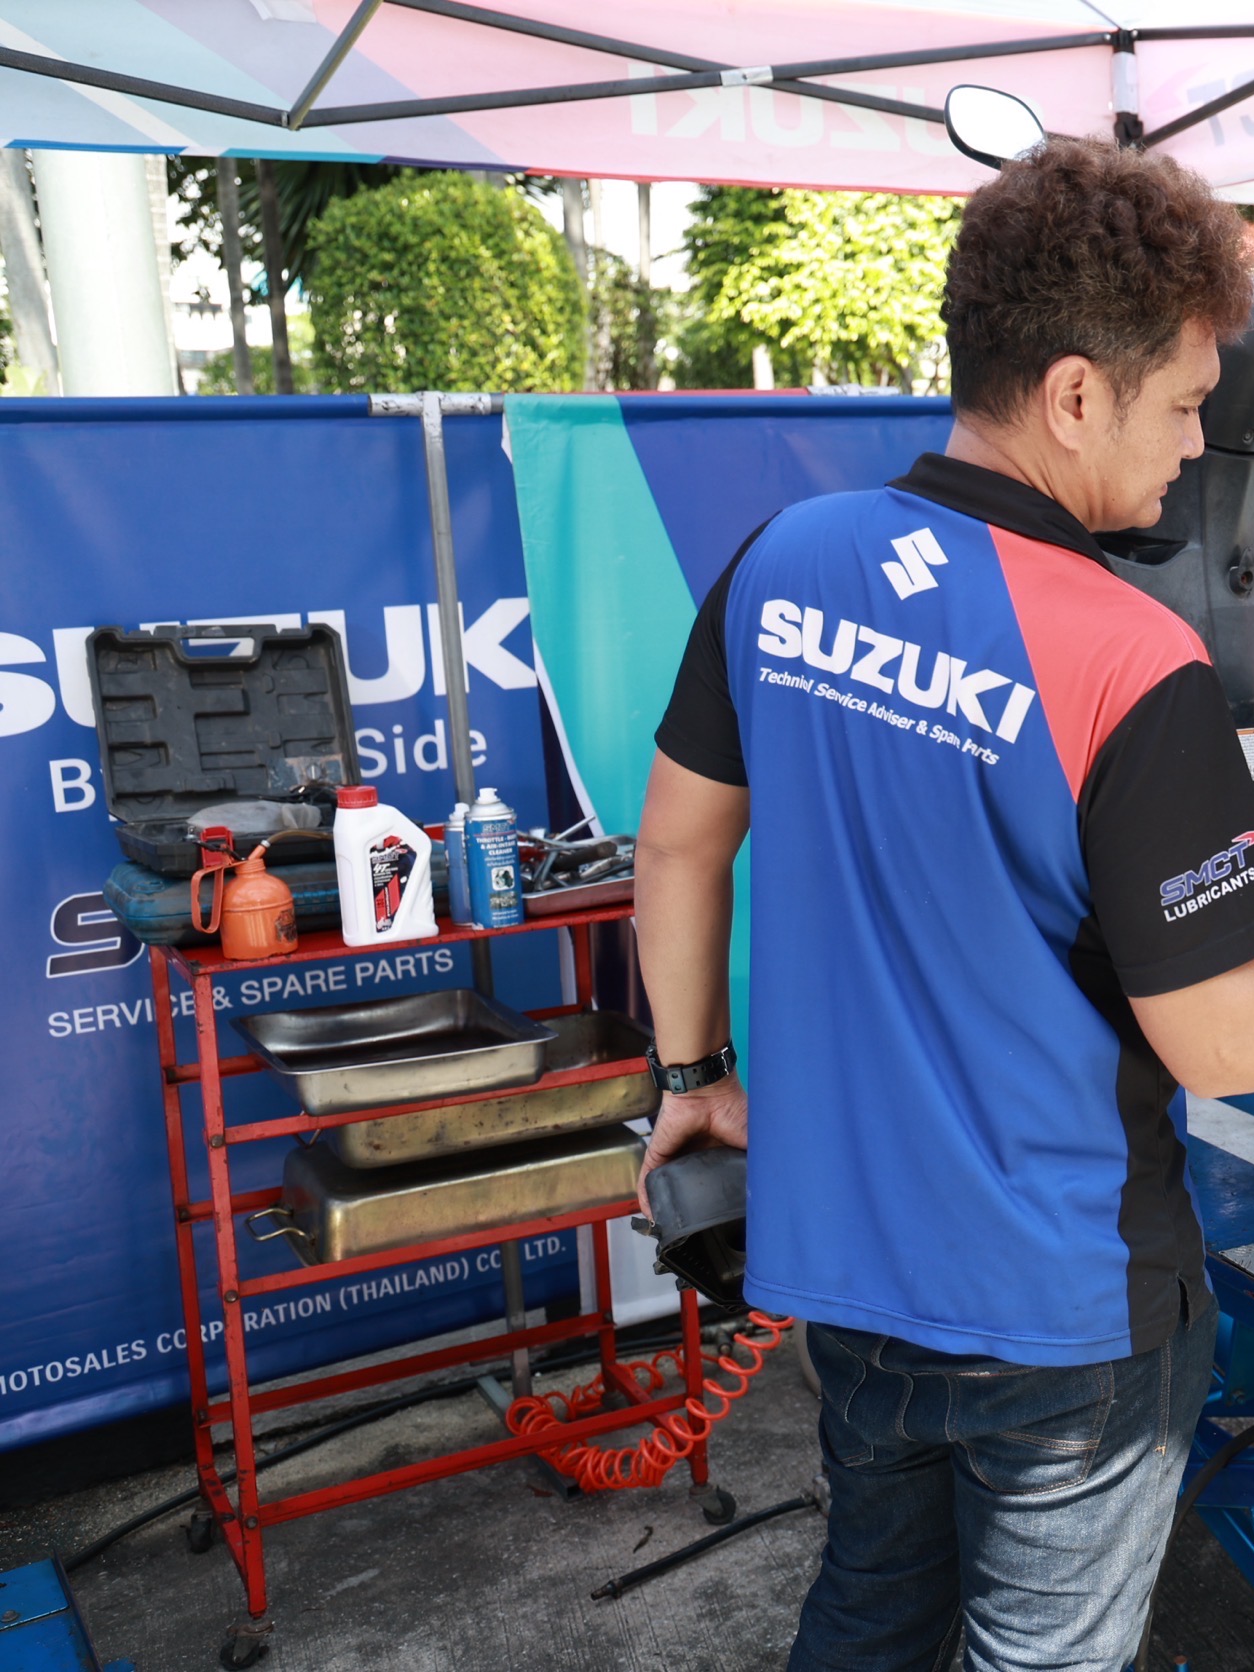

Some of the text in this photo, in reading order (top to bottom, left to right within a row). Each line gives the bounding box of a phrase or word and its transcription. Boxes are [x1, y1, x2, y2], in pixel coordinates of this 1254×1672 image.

[758, 598, 1036, 744] SUZUKI
[867, 701, 916, 730] Adviser
[915, 720, 929, 736] &
[1160, 838, 1250, 906] SMCT
[240, 967, 348, 1005] SPARE
[356, 948, 454, 987] PARTS
[339, 1257, 470, 1311] (THAILAND)
[523, 1236, 567, 1261] LTD.
